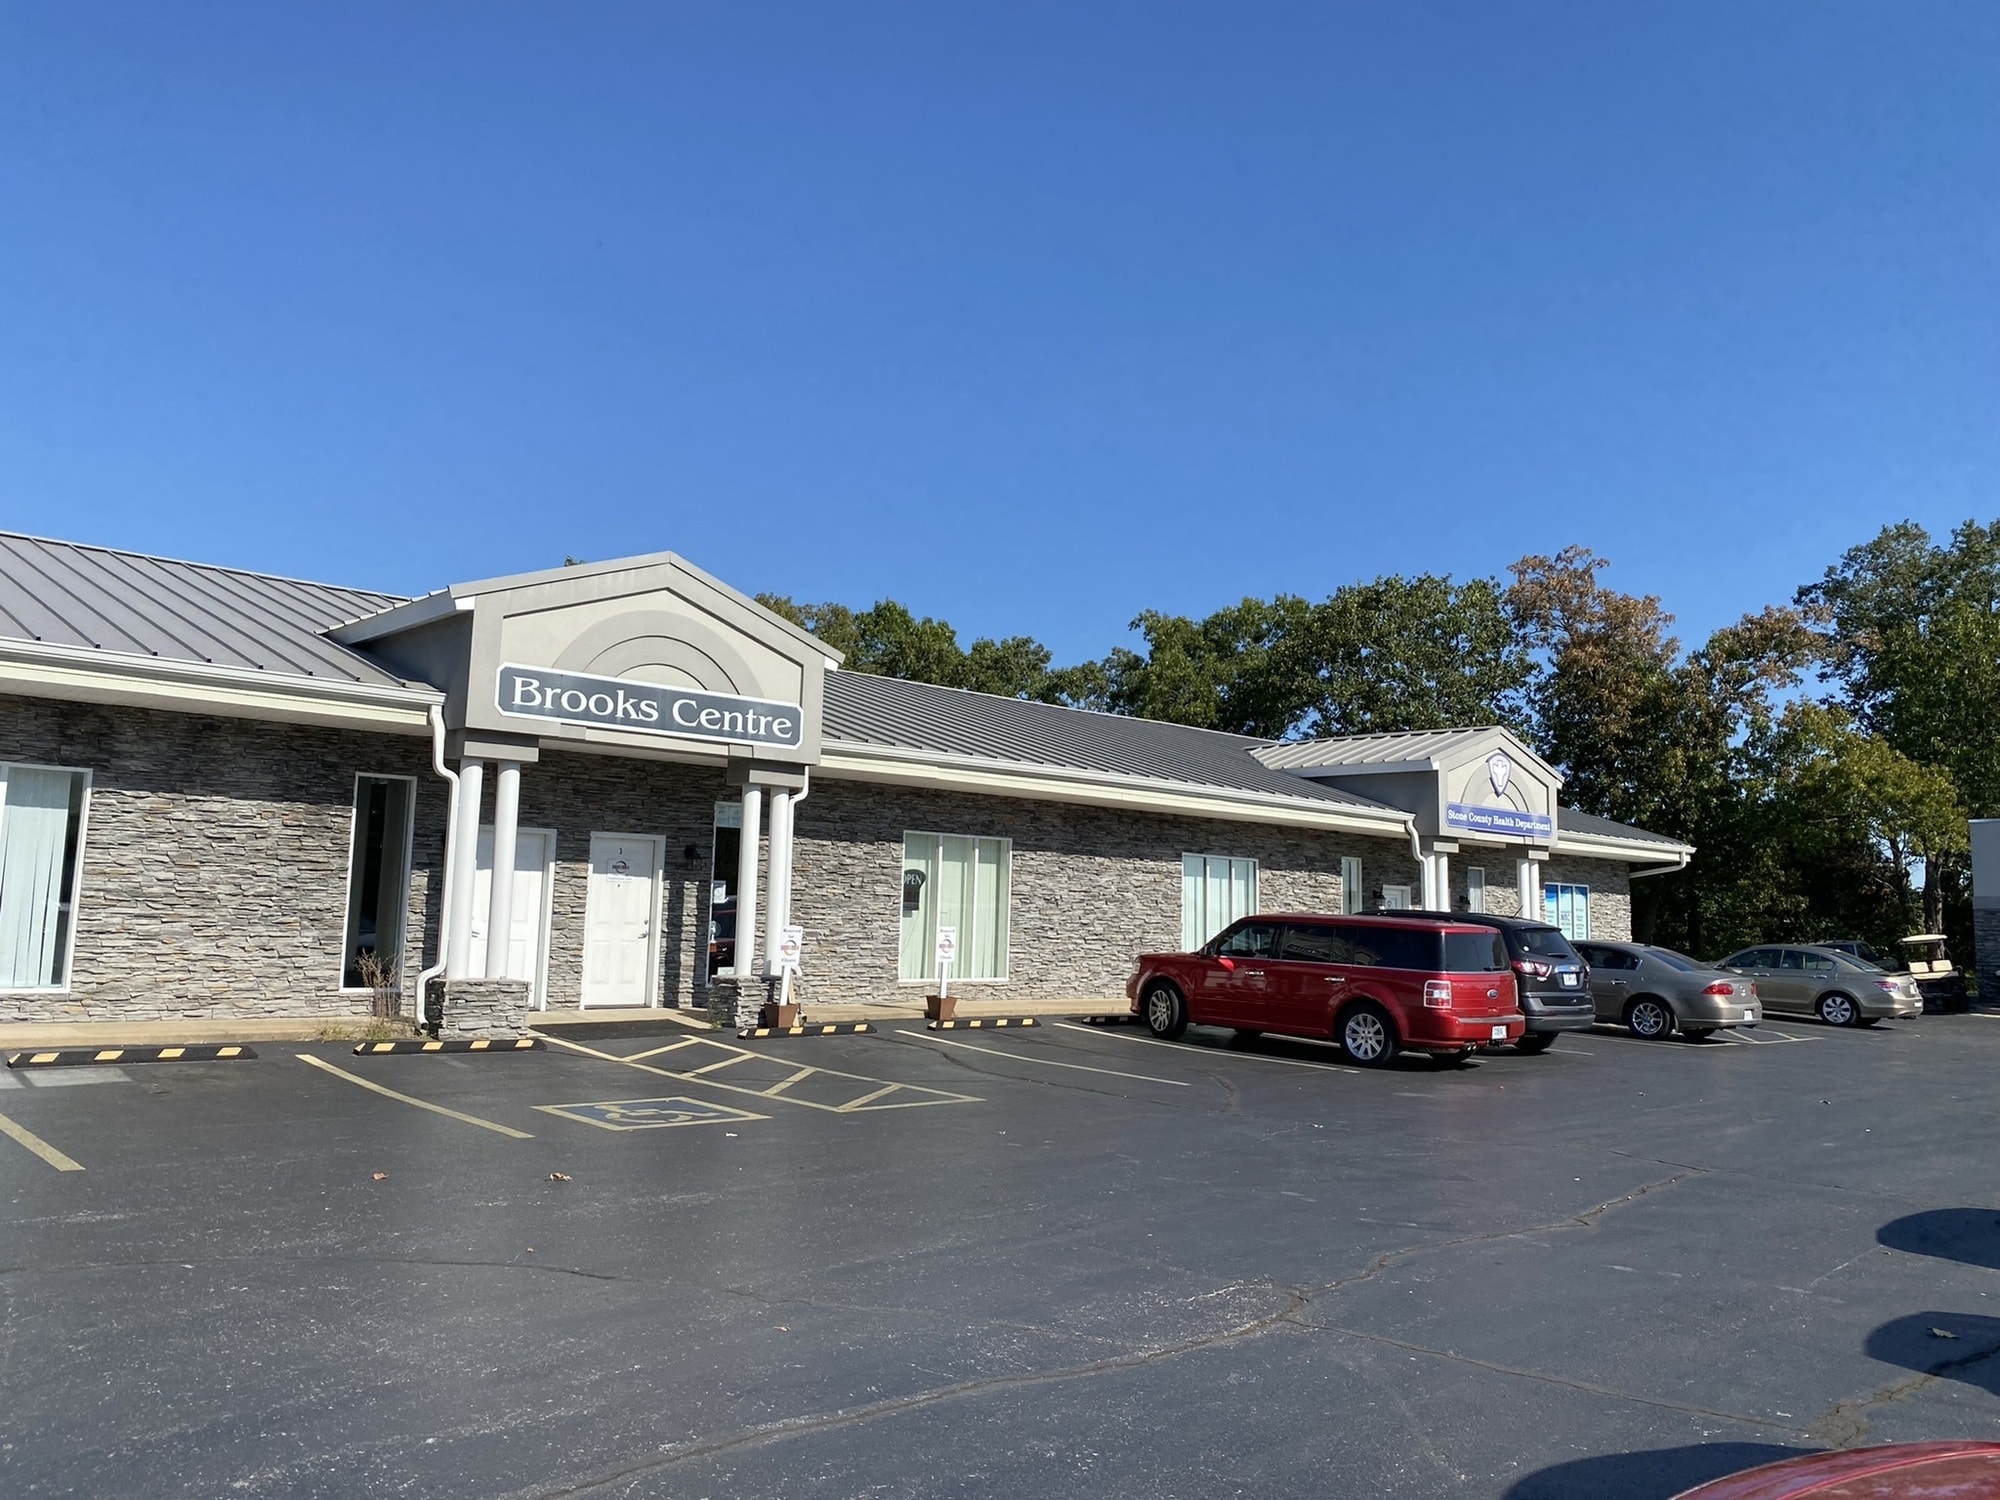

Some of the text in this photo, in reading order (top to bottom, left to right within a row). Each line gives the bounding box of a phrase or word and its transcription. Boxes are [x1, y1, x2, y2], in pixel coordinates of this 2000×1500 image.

[512, 676, 792, 738] Brooks Centre
[1447, 809, 1551, 831] Stone County Health Department
